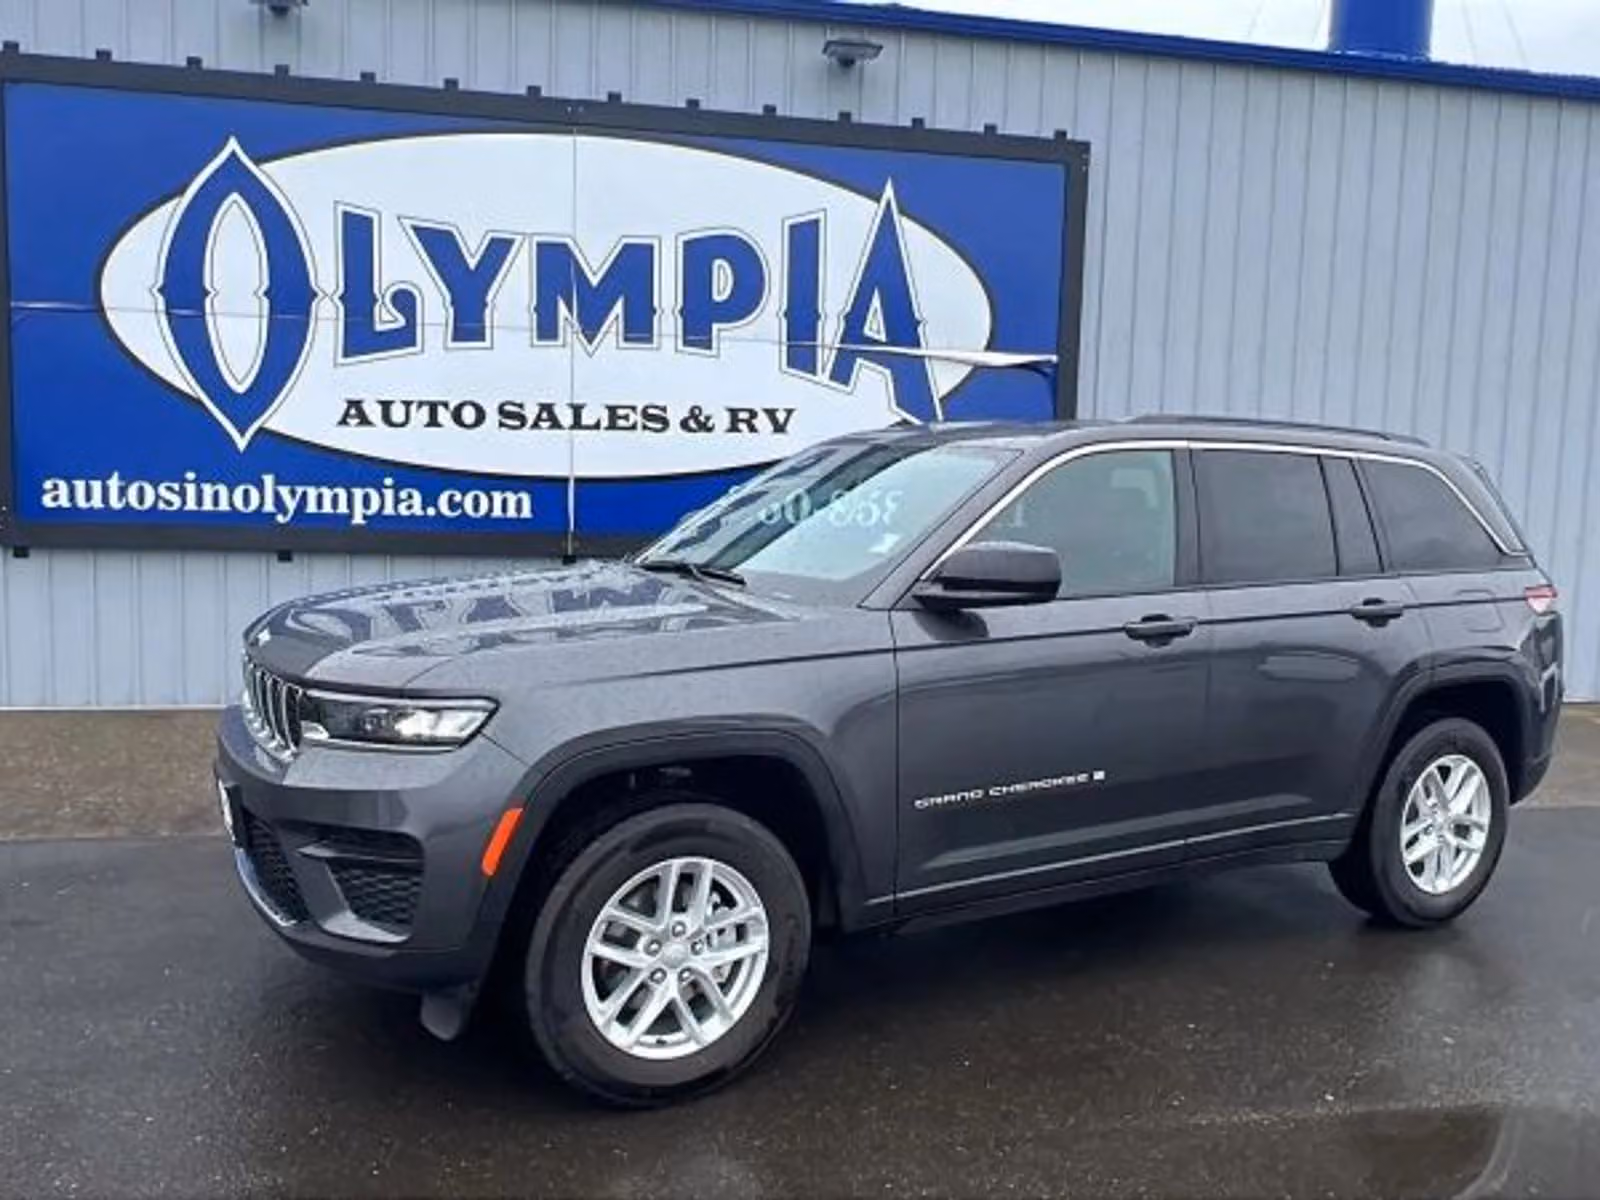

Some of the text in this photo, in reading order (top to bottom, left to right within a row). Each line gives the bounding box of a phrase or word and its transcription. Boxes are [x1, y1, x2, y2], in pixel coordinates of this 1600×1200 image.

[151, 136, 944, 452] OLYMPIA
[337, 399, 796, 434] AUTO SALES & RV
[41, 471, 533, 524] autosinolympia.com
[914, 788, 984, 809] GRAND
[988, 773, 1088, 796] CHEROKEE
